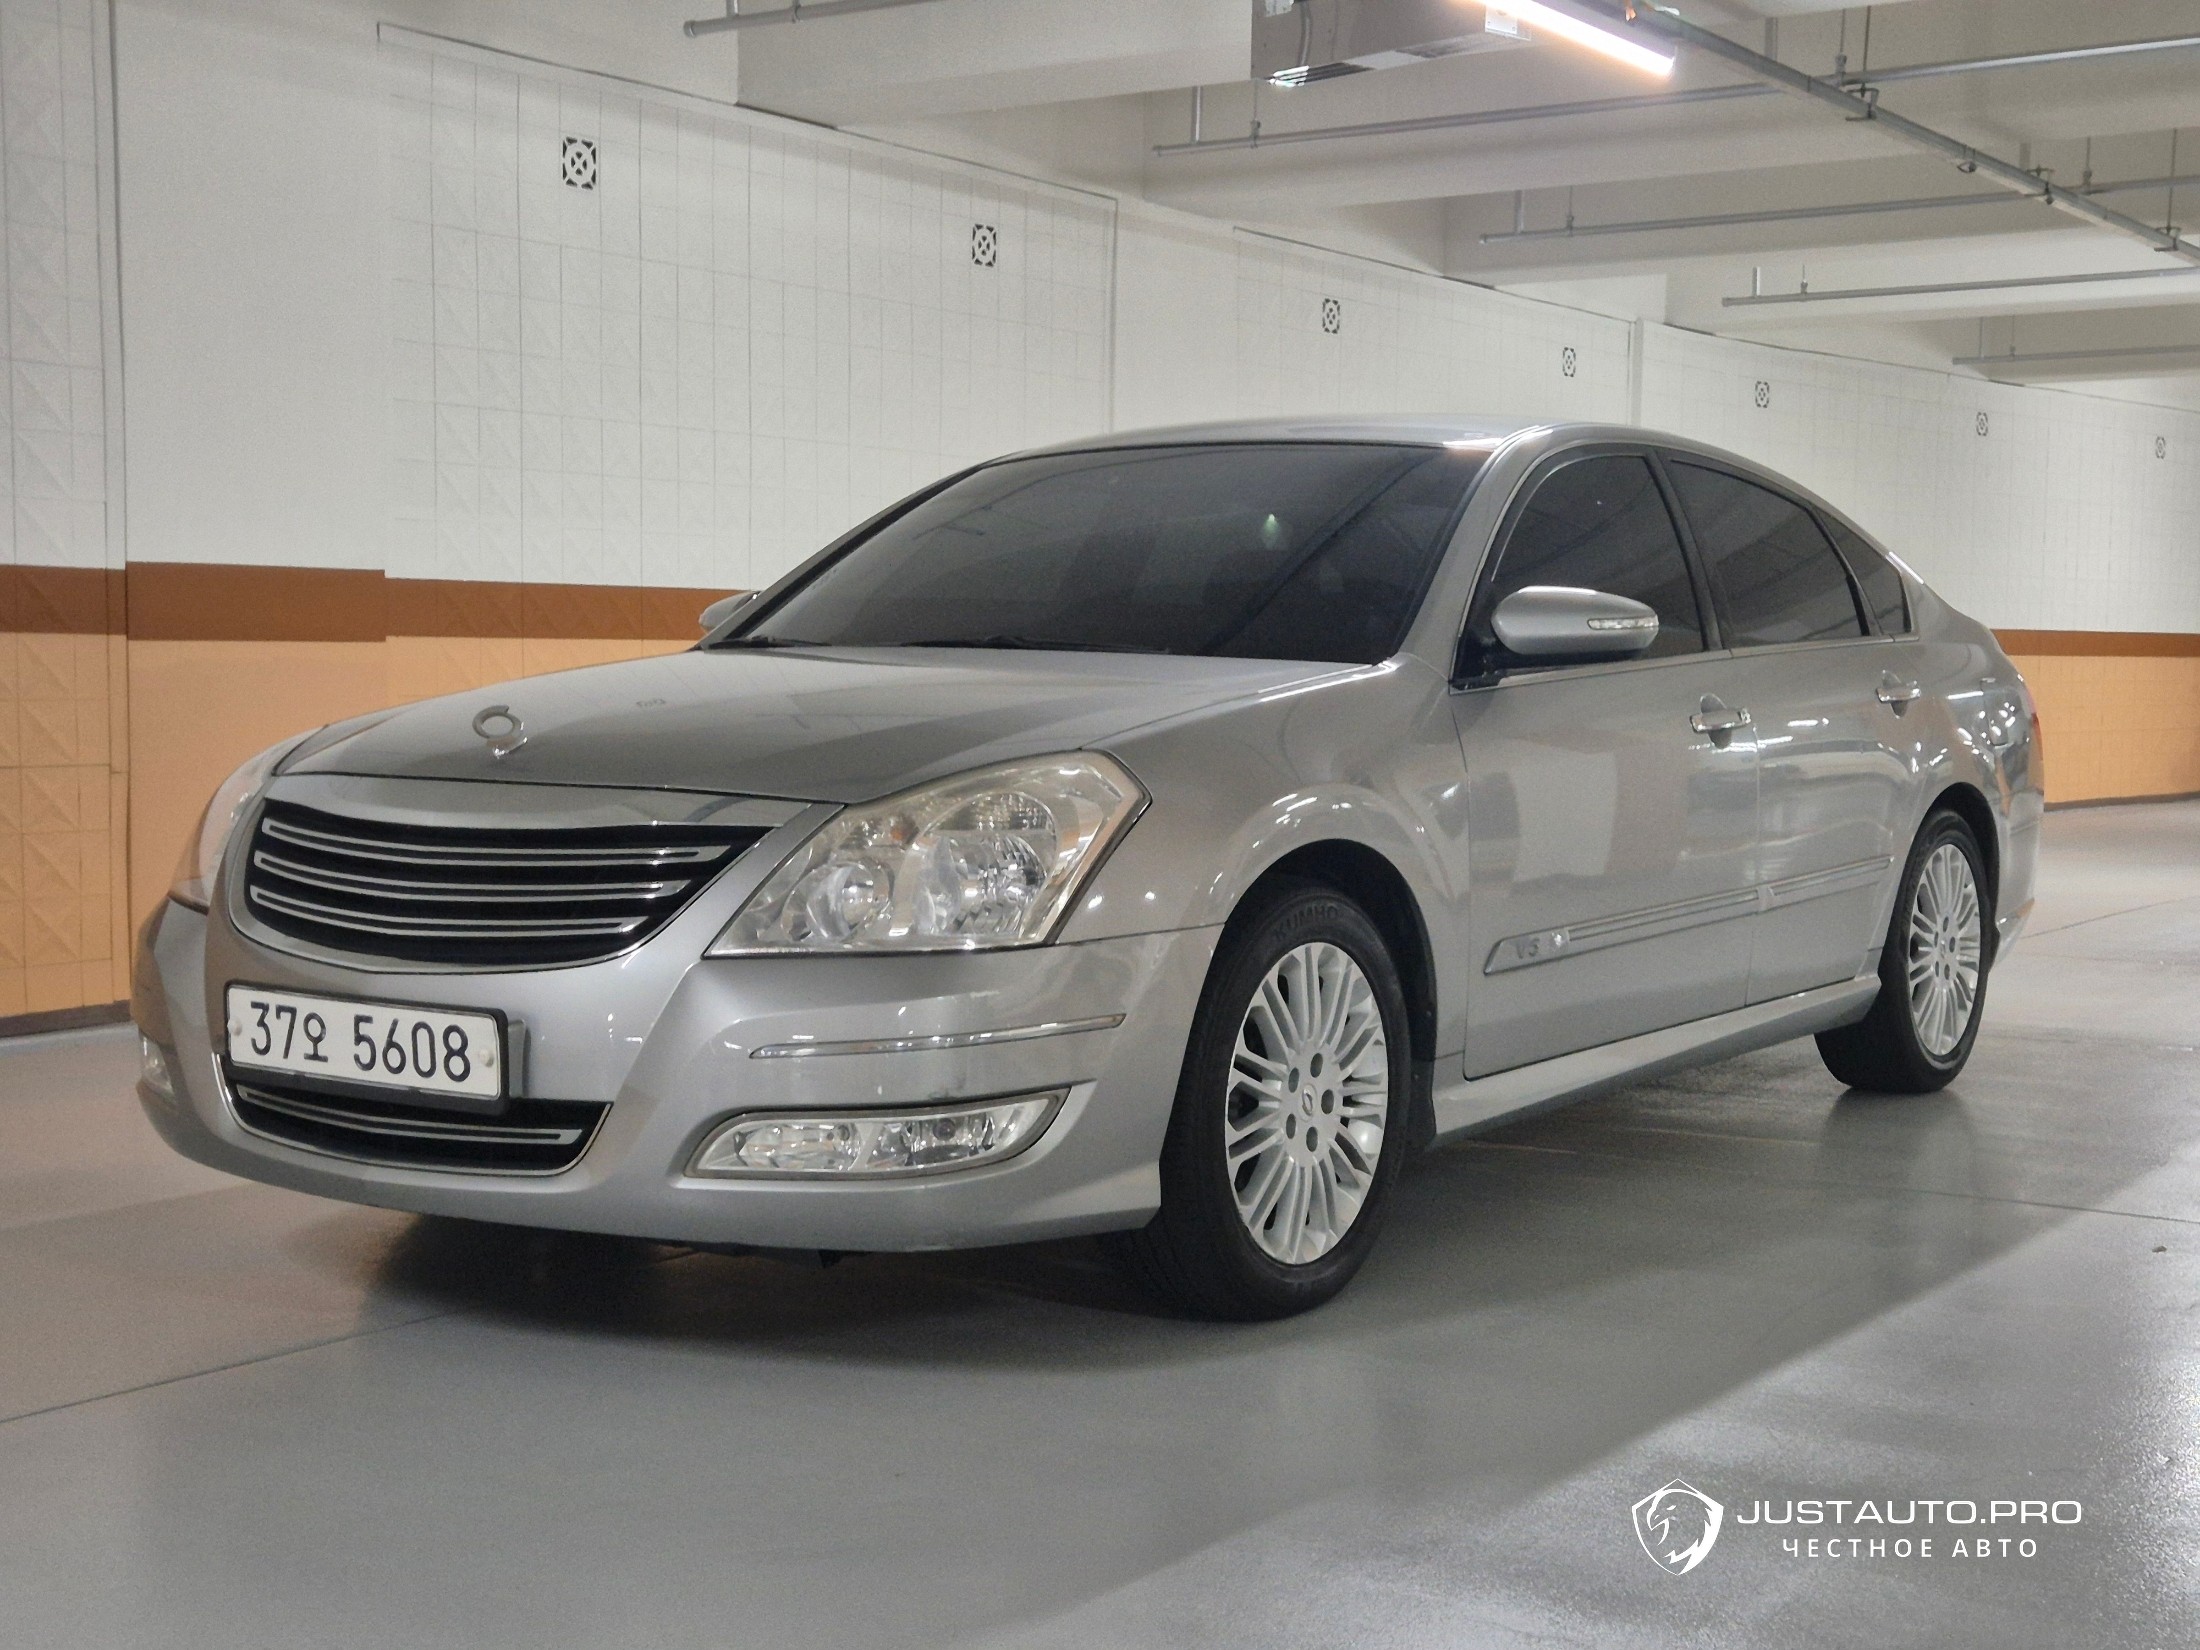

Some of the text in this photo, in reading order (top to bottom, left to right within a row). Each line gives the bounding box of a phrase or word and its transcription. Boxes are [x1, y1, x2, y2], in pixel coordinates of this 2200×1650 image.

[1274, 904, 1338, 938] KUMHO
[250, 1001, 471, 1083] 37오 5608
